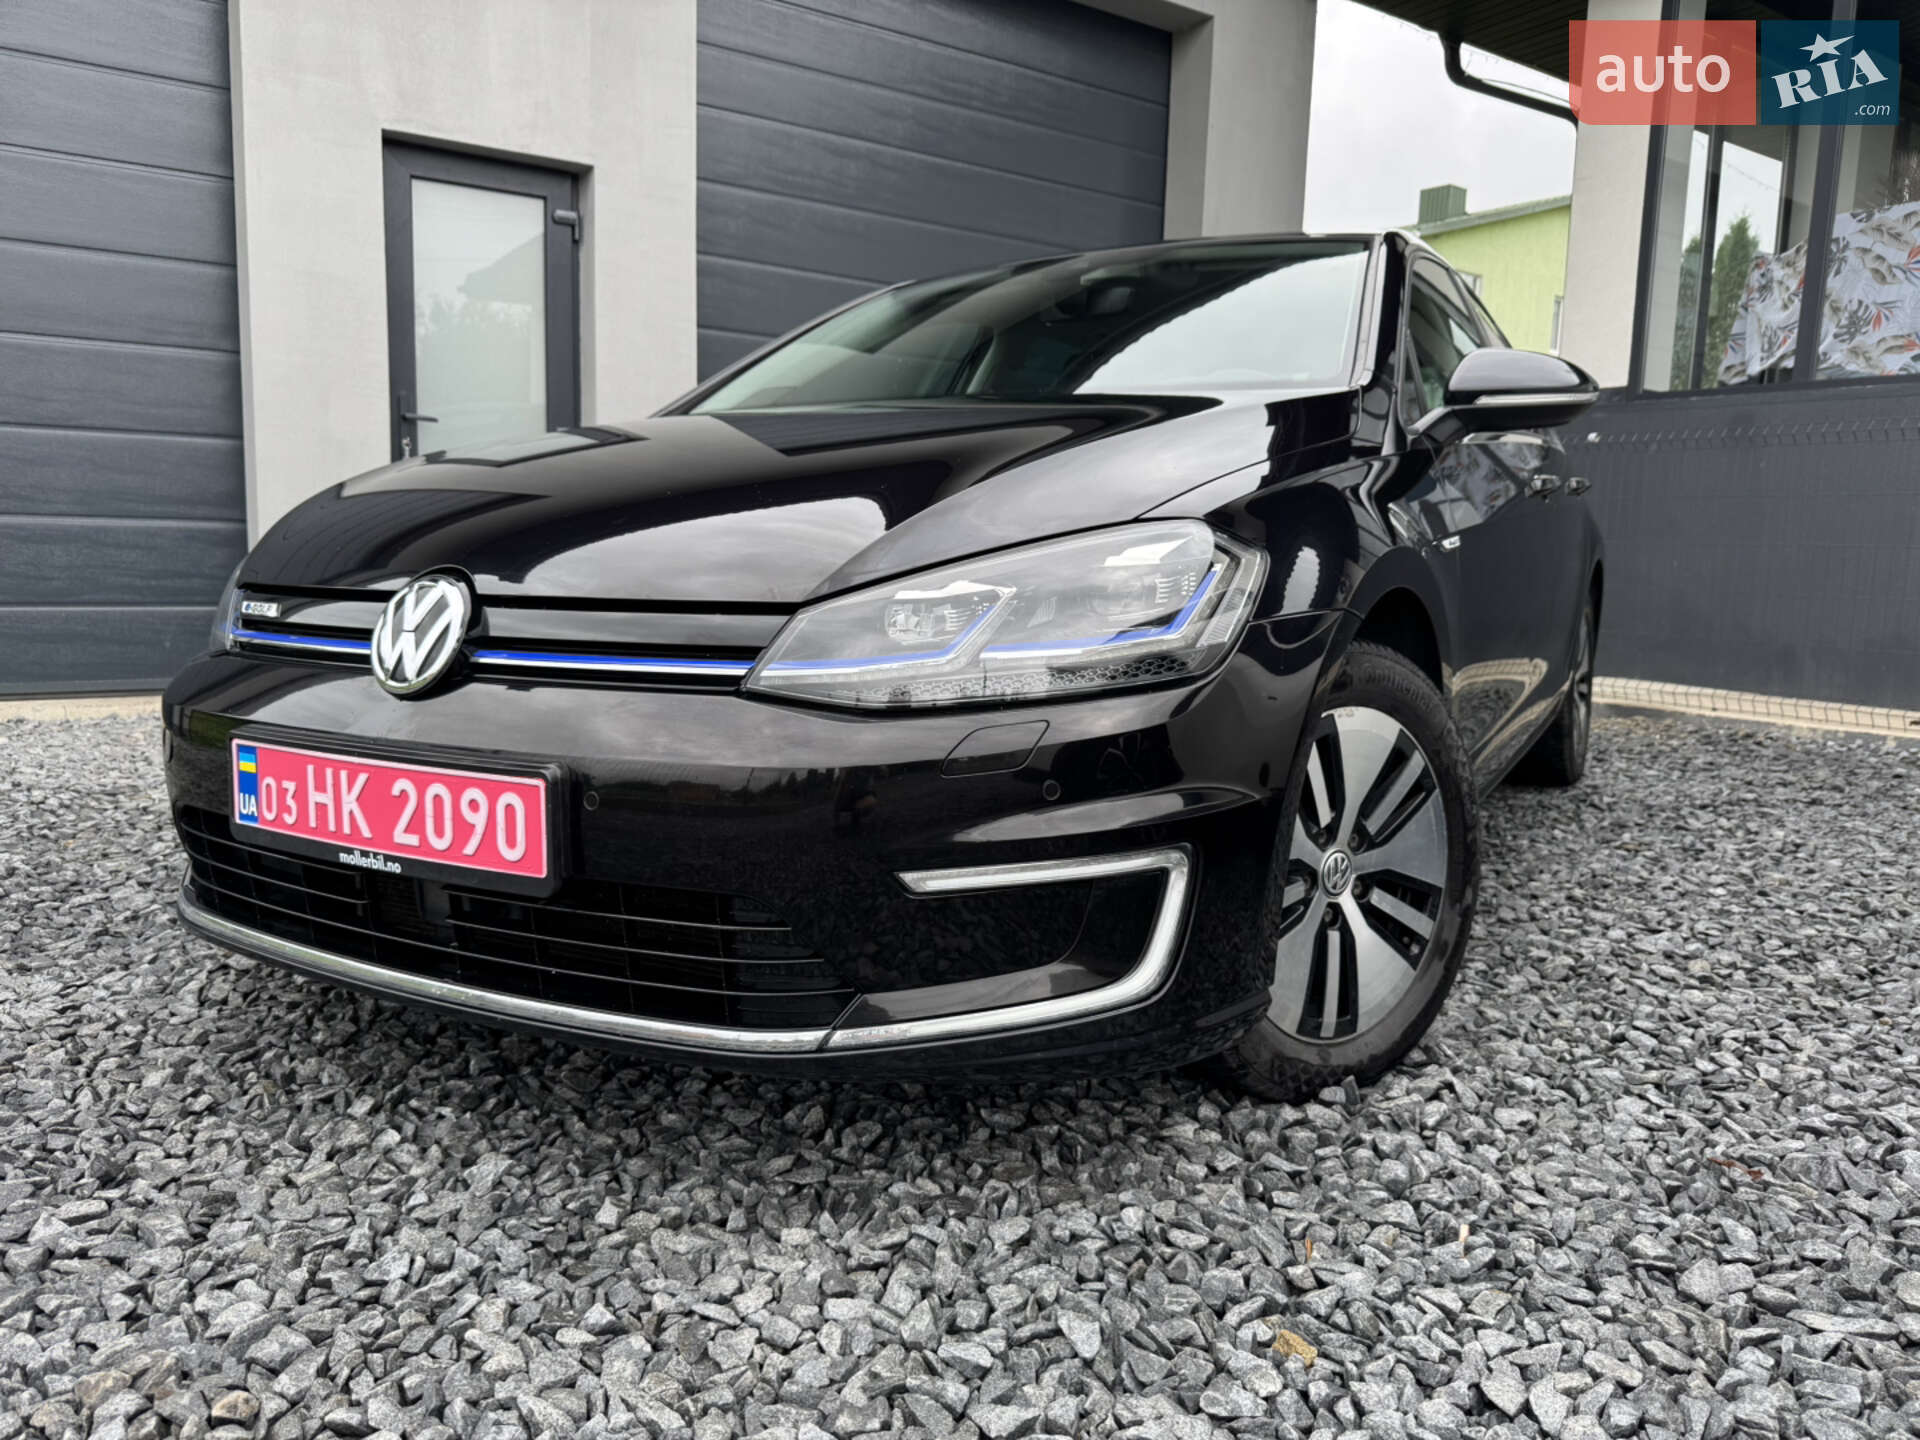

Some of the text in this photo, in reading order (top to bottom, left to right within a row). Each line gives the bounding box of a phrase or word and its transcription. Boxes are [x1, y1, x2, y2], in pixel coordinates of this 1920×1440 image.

[240, 792, 258, 817] UA
[390, 777, 527, 863] 2090
[339, 850, 402, 874] mollerbil.no
